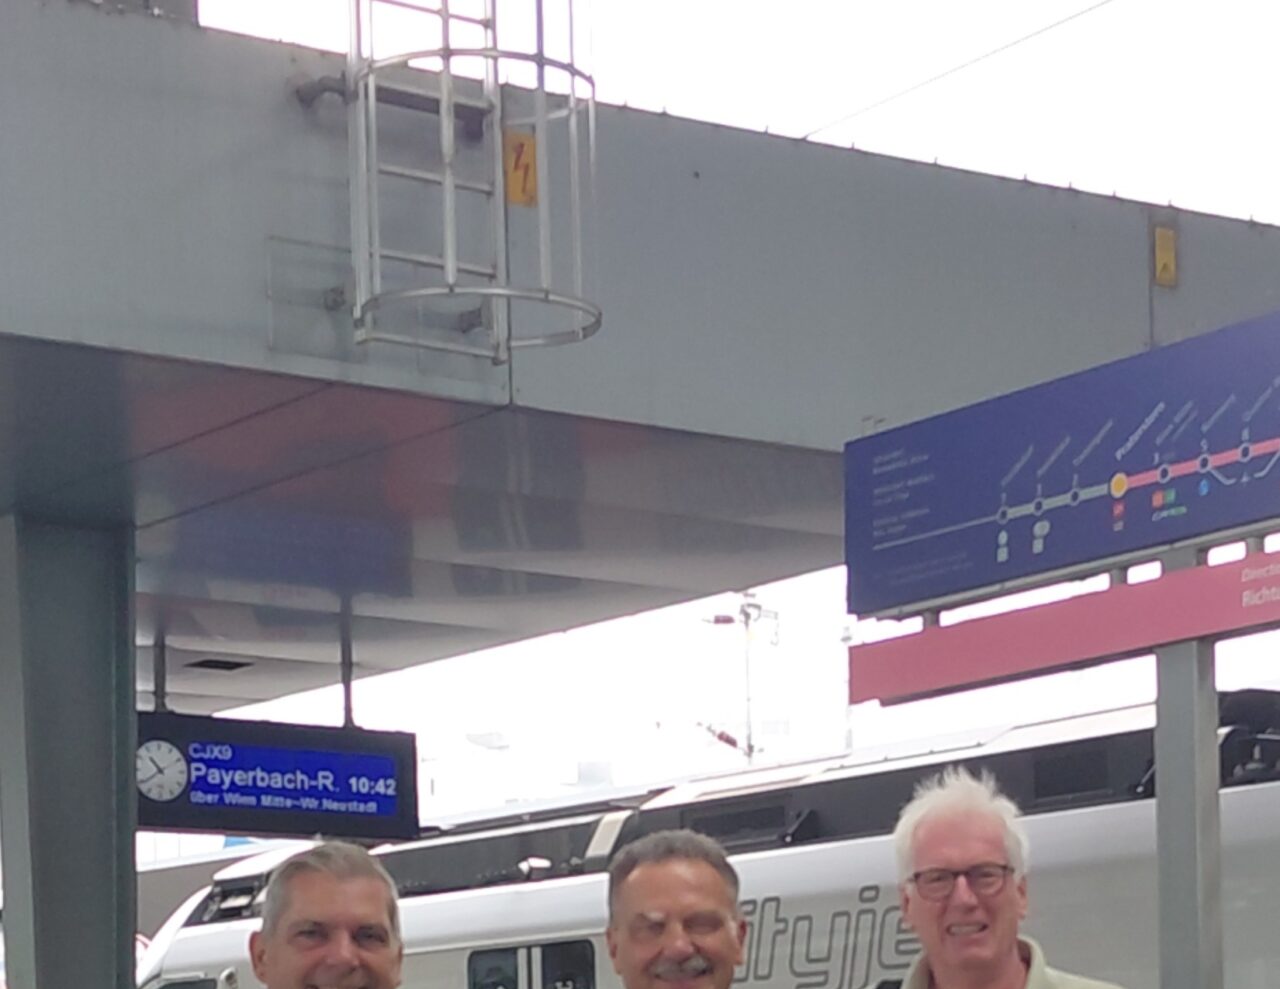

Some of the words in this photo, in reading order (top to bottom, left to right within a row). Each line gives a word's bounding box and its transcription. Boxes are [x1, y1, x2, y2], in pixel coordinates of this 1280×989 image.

[188, 742, 233, 760] CJX9
[190, 761, 341, 793] Payerbach-R.
[348, 776, 397, 796] 10:42
